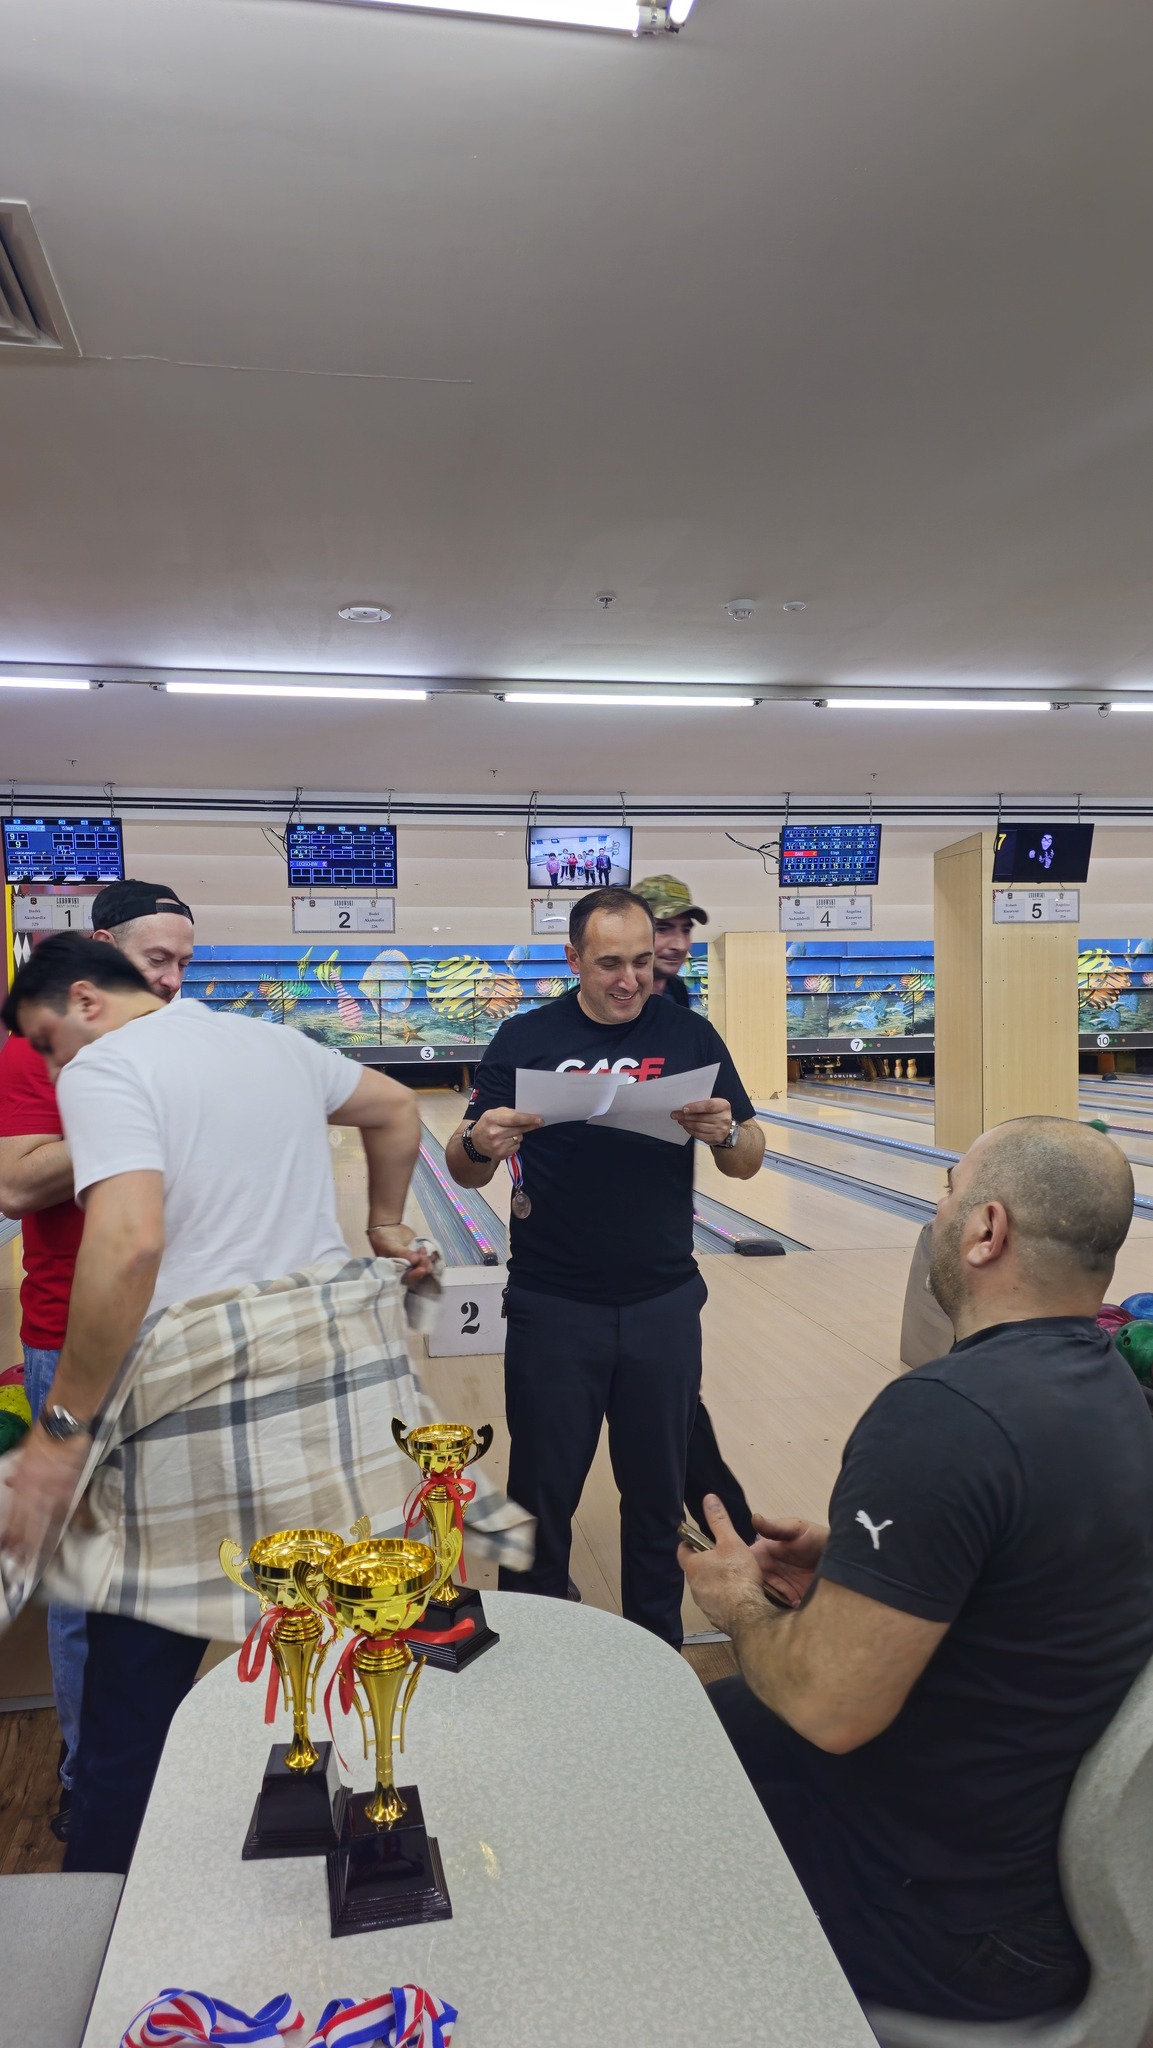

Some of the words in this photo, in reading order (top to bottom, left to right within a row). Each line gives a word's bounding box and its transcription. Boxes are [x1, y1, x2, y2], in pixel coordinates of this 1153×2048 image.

[998, 833, 1007, 850] 7
[65, 910, 72, 927] 1
[820, 910, 831, 927] 4
[1031, 903, 1042, 919] 5
[338, 911, 351, 929] 2
[854, 1041, 860, 1051] 7
[1098, 1036, 1109, 1045] 10
[424, 1049, 431, 1059] 3
[460, 1301, 480, 1335] 2
